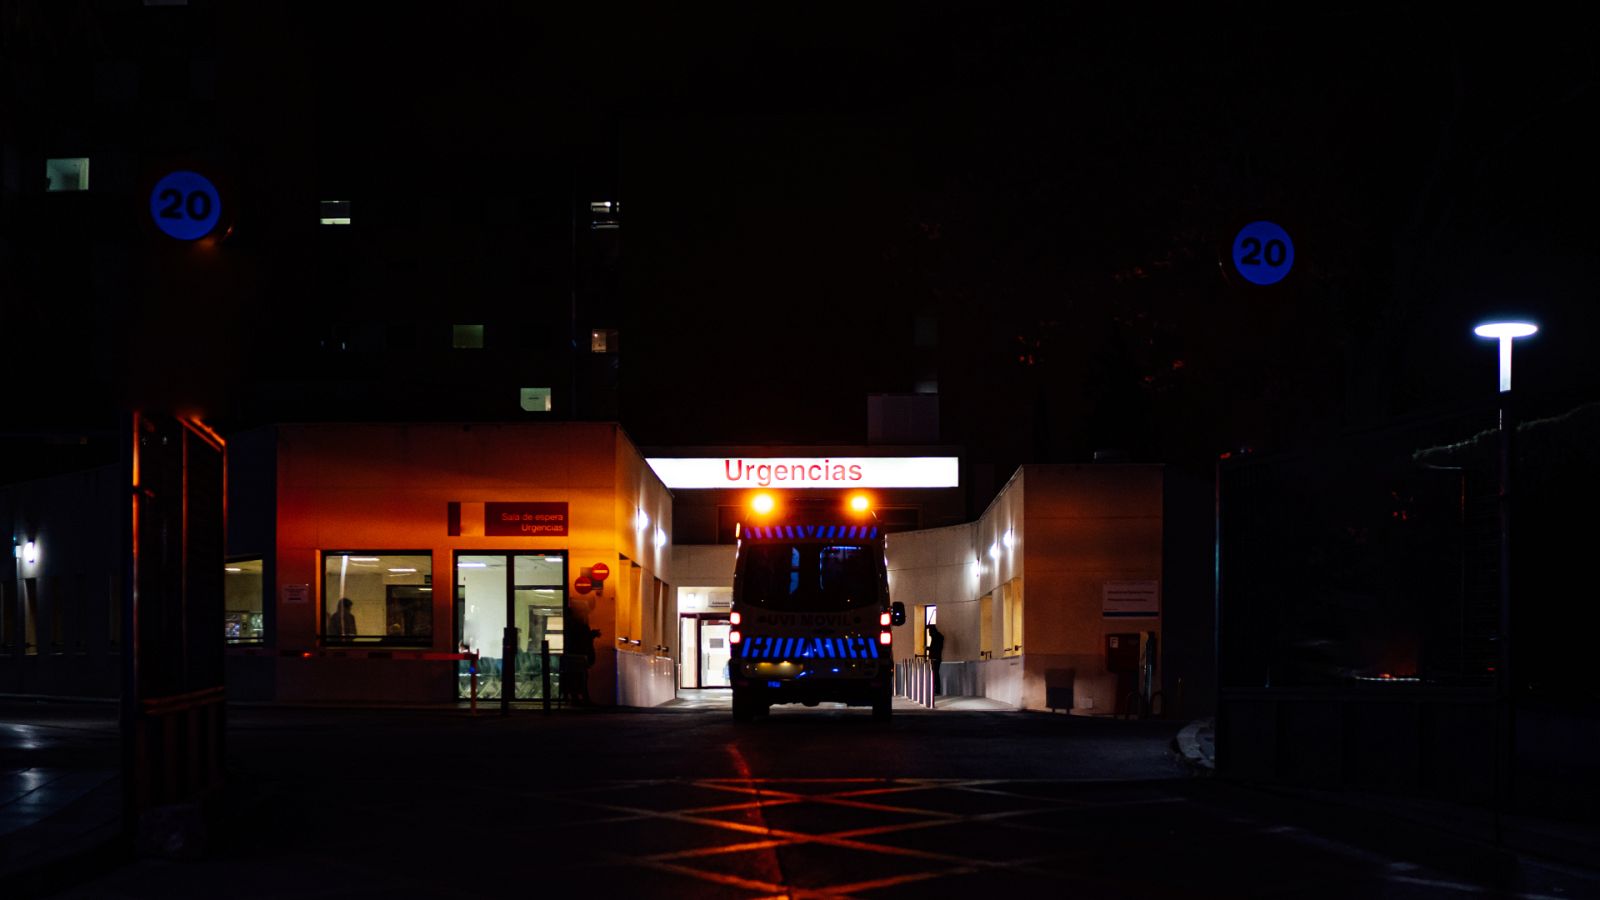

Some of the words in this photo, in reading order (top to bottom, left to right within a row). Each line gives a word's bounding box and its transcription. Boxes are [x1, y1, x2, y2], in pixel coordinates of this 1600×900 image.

[160, 189, 210, 220] 20
[1241, 237, 1286, 266] 20
[725, 459, 863, 487] Urgencias
[501, 512, 520, 521] Sala
[522, 512, 533, 521] de
[535, 514, 564, 523] espera
[521, 522, 564, 533] Urgencias
